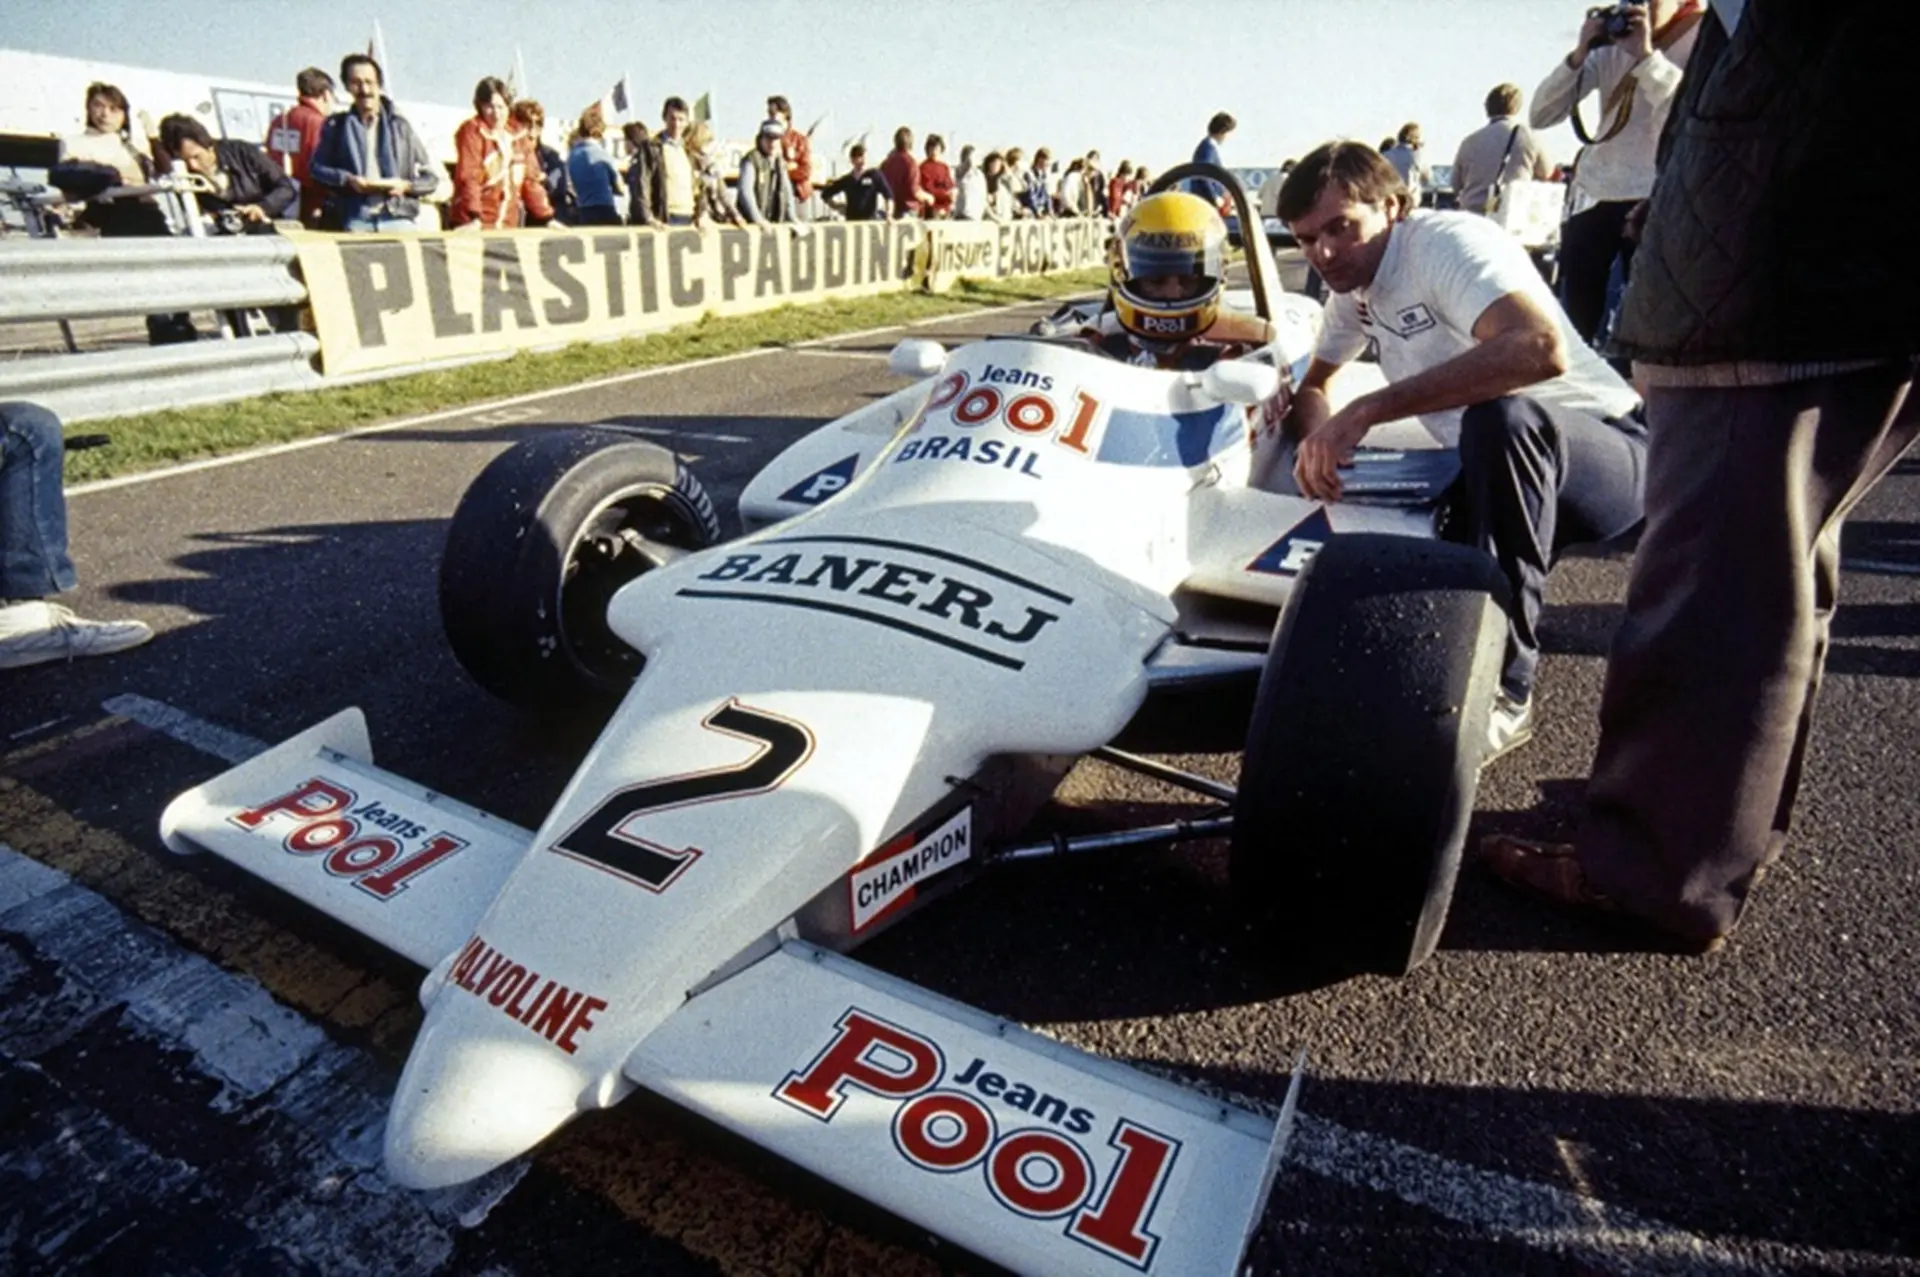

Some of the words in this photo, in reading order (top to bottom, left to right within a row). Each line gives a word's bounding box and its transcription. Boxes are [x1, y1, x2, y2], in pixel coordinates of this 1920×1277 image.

[338, 229, 704, 347] PLASTIC
[721, 221, 915, 301] PADDING
[997, 222, 1059, 277] EAGLE
[1063, 220, 1103, 268] STAR
[1143, 316, 1187, 333] Pool
[897, 369, 1102, 458] Pool
[979, 364, 1055, 391] Jeans
[802, 473, 846, 499] P
[893, 436, 1043, 480] BRASIL
[697, 553, 1059, 644] BANERJ
[353, 801, 427, 840] Jeans
[550, 697, 816, 893] 2
[227, 776, 470, 901] Pool
[857, 825, 967, 908] CHAMPION
[954, 1058, 1095, 1134] Jeans
[772, 1007, 1181, 1271] Pool
